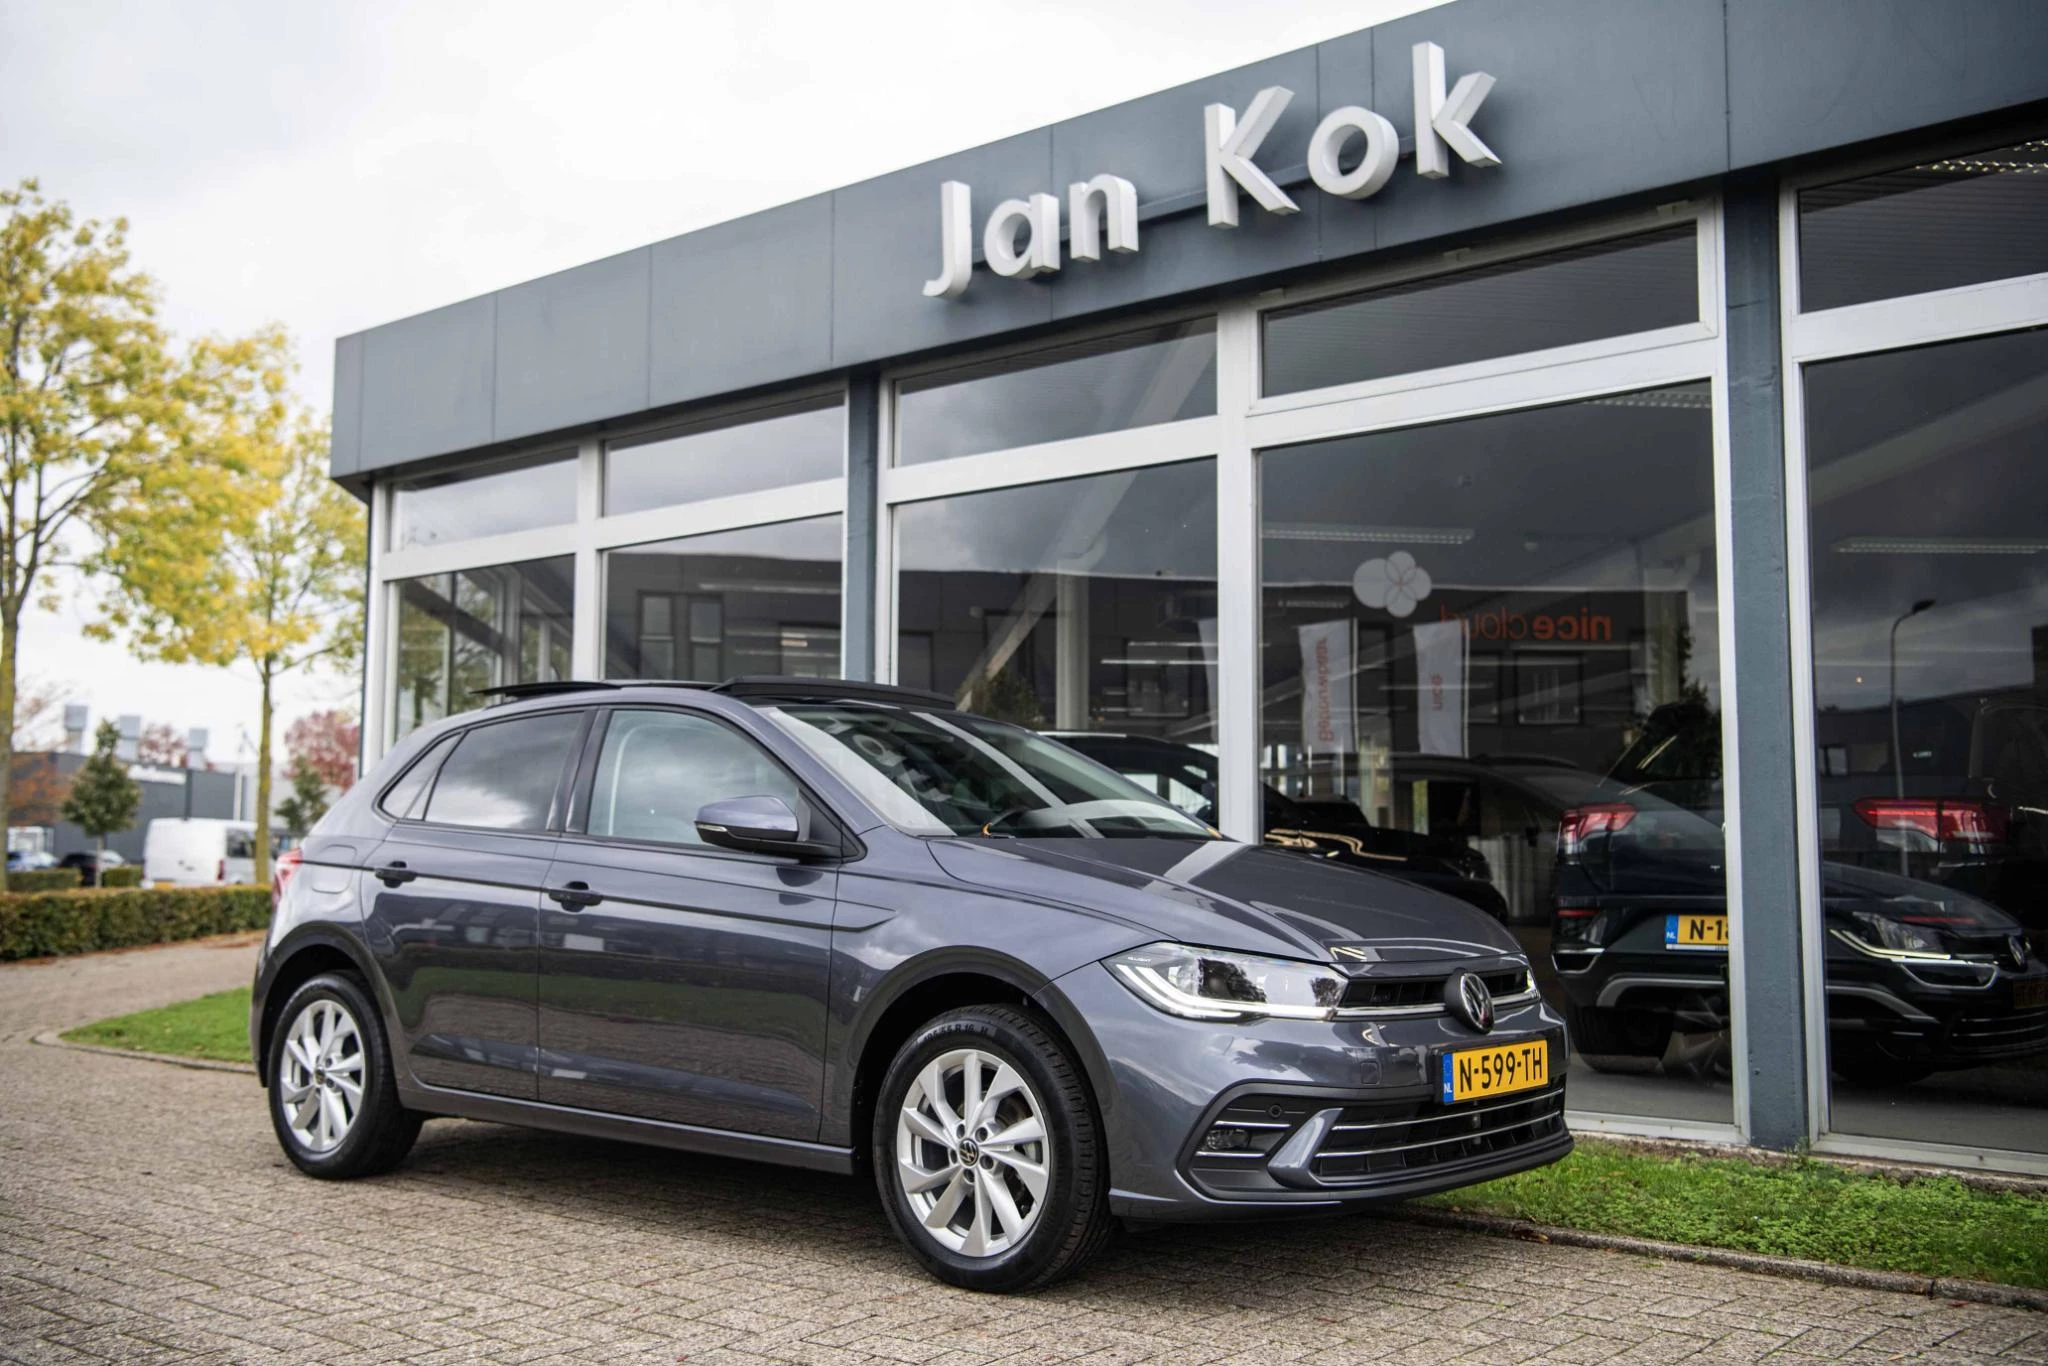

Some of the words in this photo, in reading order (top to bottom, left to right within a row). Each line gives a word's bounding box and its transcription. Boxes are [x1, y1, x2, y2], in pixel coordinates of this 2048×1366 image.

[922, 173, 1138, 298] Jan
[1204, 41, 1502, 228] Kok
[1666, 931, 1676, 939] NL
[1689, 919, 1728, 941] N-1
[1459, 1047, 1543, 1093] N-599-TH
[1443, 1082, 1453, 1094] NL
